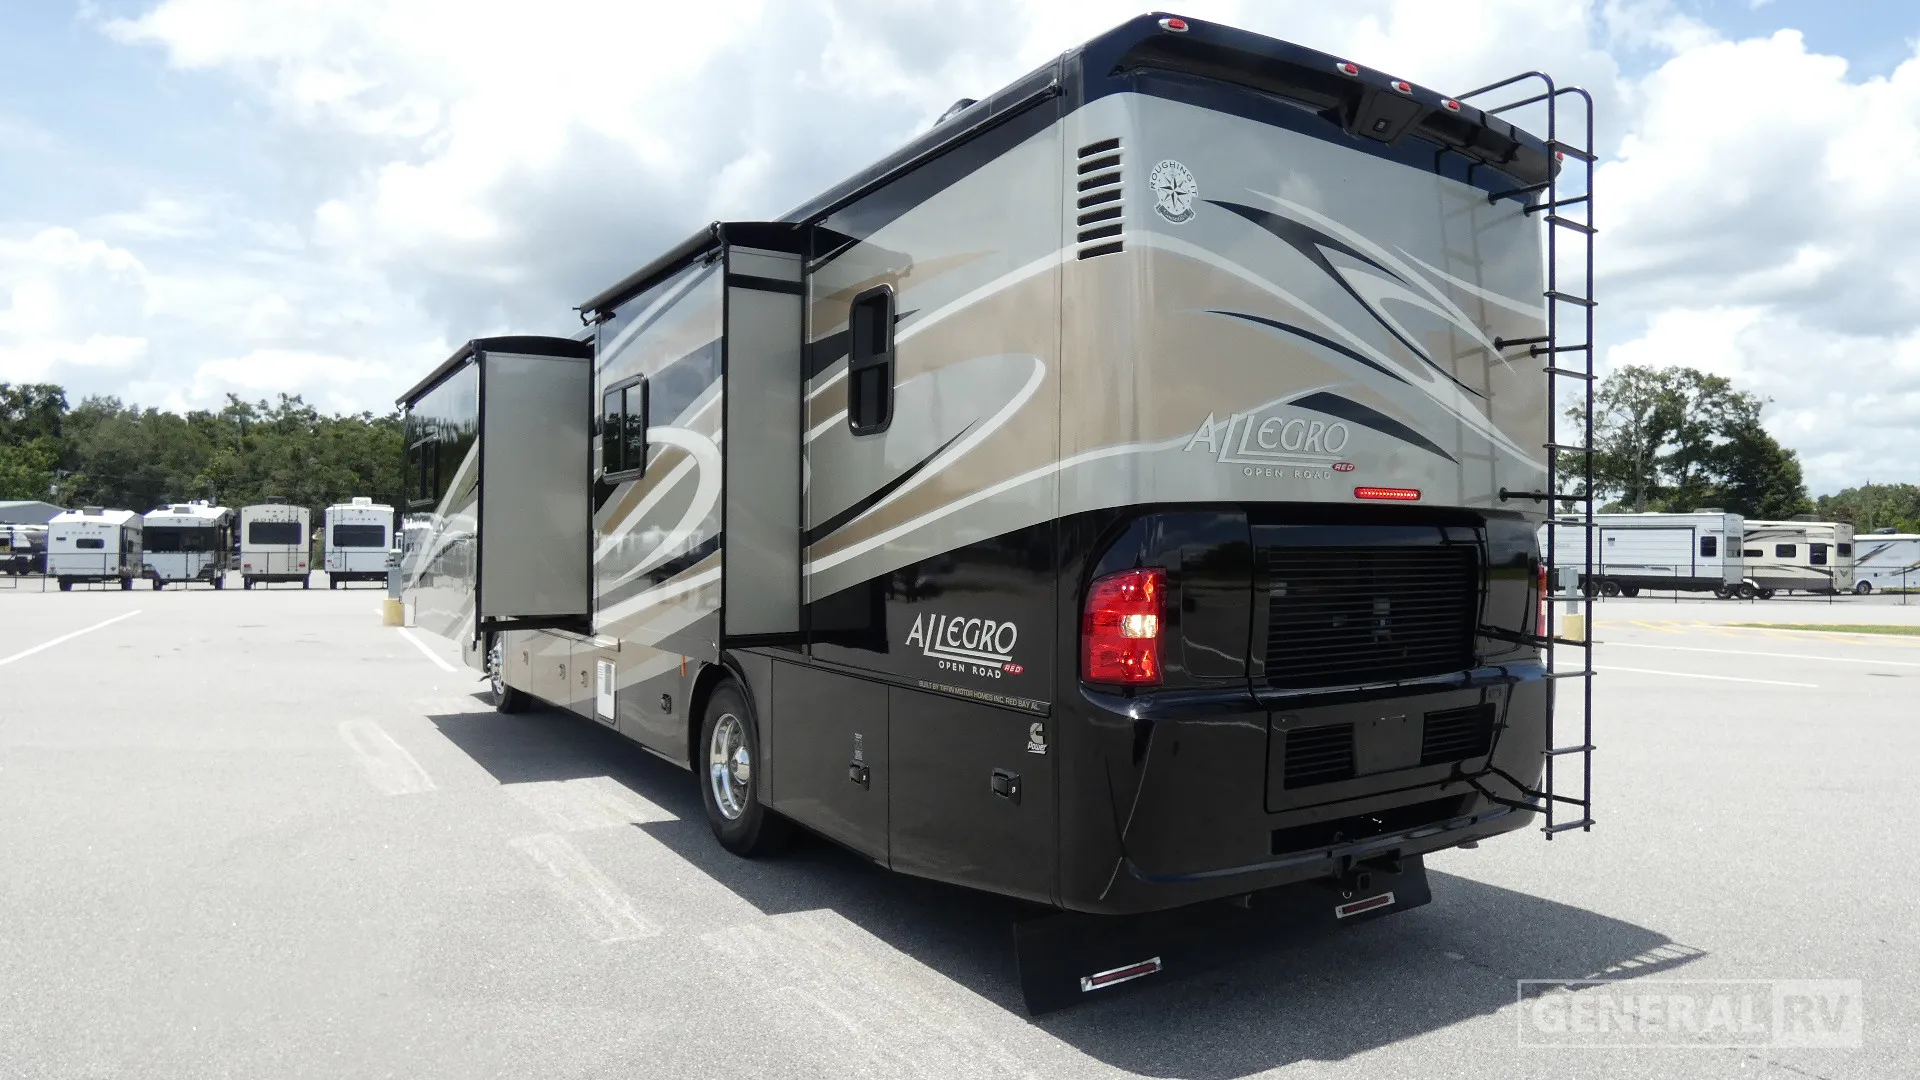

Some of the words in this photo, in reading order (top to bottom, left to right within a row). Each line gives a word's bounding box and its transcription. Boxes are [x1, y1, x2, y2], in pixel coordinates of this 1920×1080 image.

[1150, 161, 1193, 190] ROUGHING
[1182, 411, 1350, 468] ALLEGRO
[1243, 466, 1283, 478] OPEN
[1294, 469, 1332, 480] ROAD
[1333, 463, 1355, 472] RED
[905, 612, 1018, 668] ALLEGRO
[938, 660, 965, 673] OPEN
[972, 666, 1002, 679] ROAD
[1004, 664, 1022, 674] RED
[918, 680, 932, 689] BUILT
[954, 687, 974, 697] MOTOR
[973, 691, 994, 701] HOMES
[1005, 697, 1018, 706] RED
[1018, 699, 1030, 709] BAY
